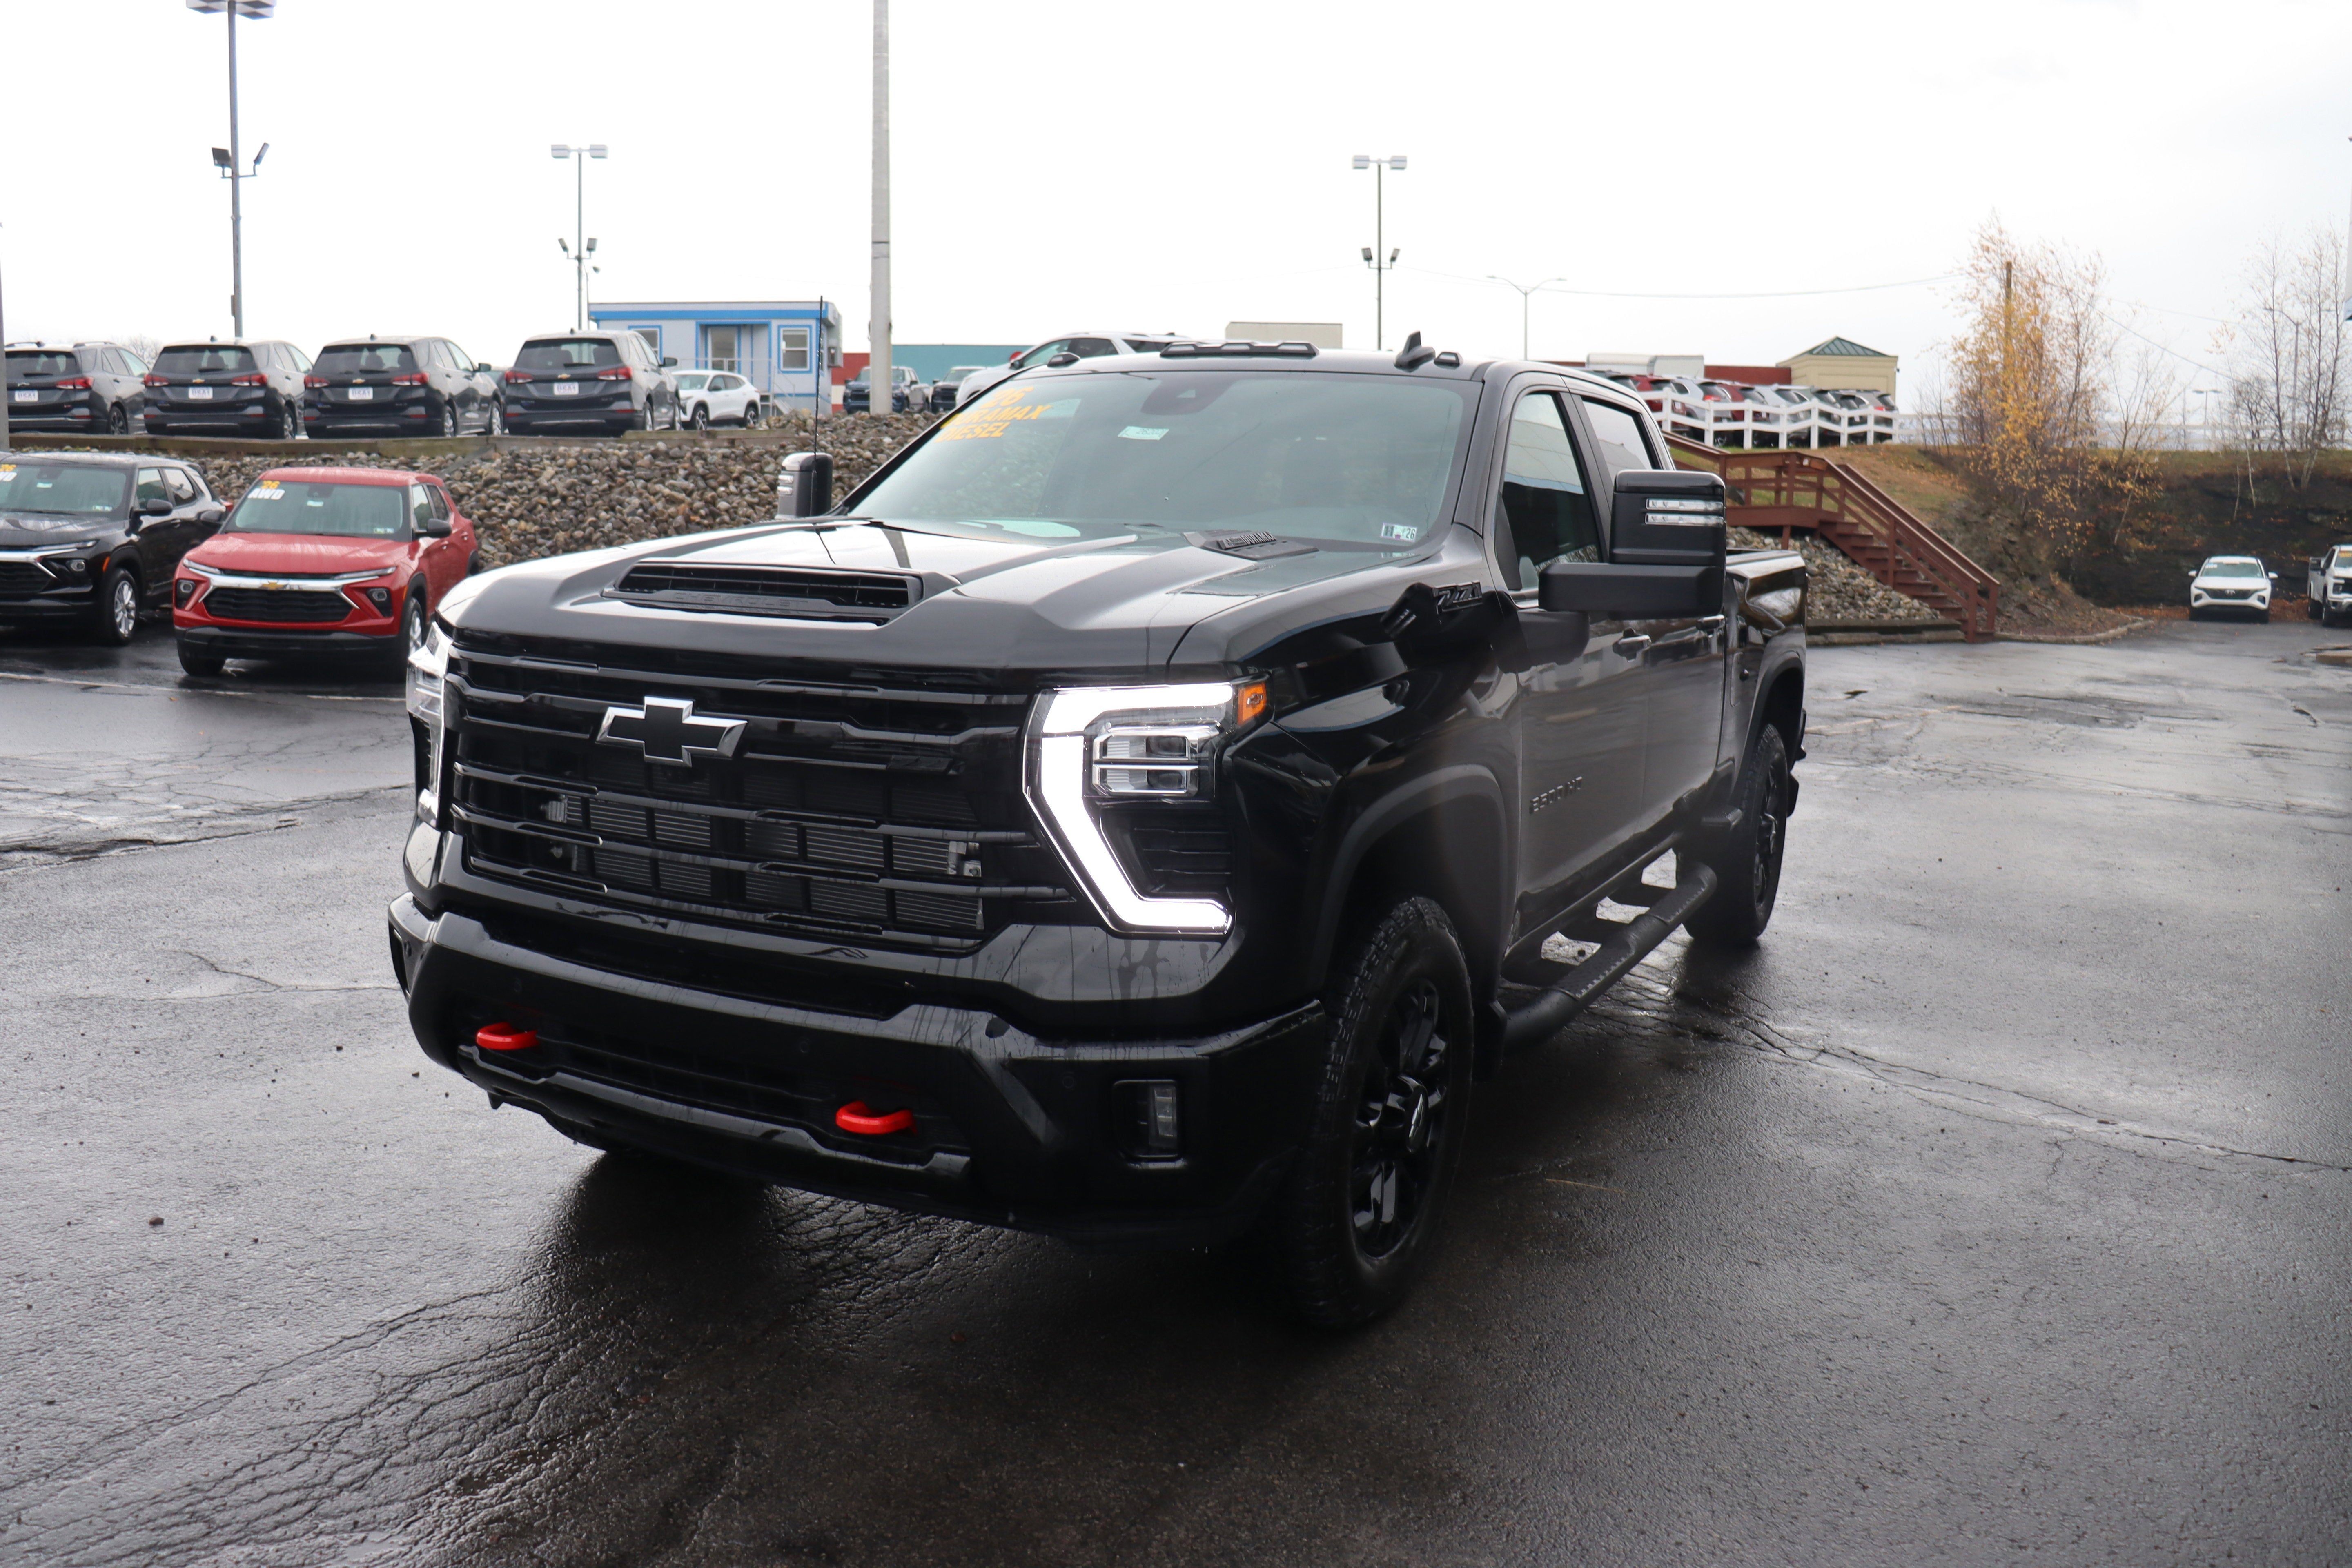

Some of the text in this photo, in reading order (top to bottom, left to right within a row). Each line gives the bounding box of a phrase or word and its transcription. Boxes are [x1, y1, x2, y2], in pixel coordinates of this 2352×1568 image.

[940, 405, 1051, 428] DURAMAX
[933, 422, 1011, 443] DIESEL
[247, 488, 285, 500] AWD
[1406, 528, 1416, 539] 26
[673, 592, 809, 607] CHEVROLET
